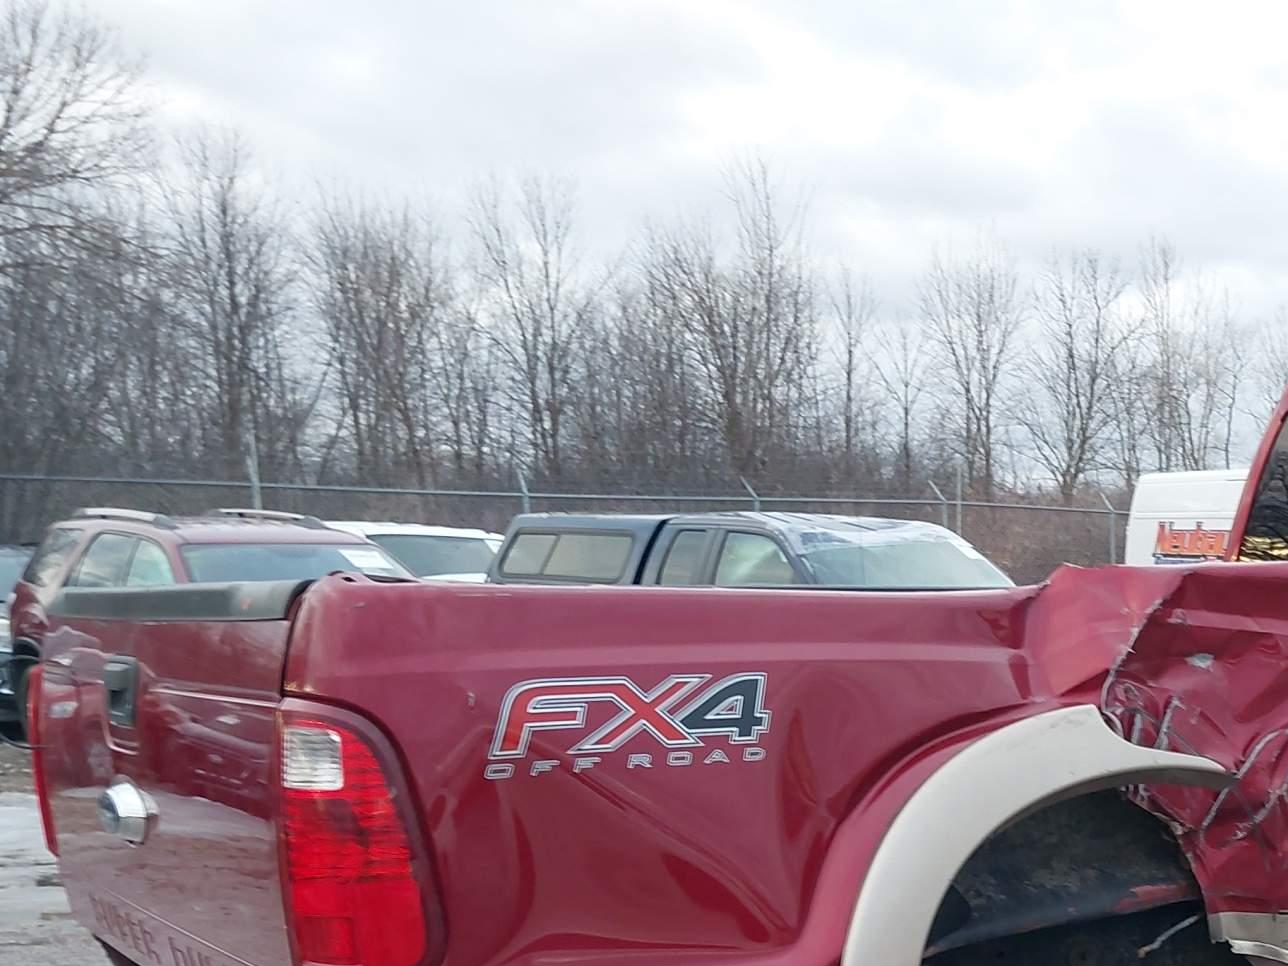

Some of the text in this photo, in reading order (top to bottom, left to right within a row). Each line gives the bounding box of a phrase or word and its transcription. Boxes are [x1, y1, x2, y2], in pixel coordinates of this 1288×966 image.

[488, 671, 772, 760] FX4
[484, 747, 767, 780] OFF ROAD
